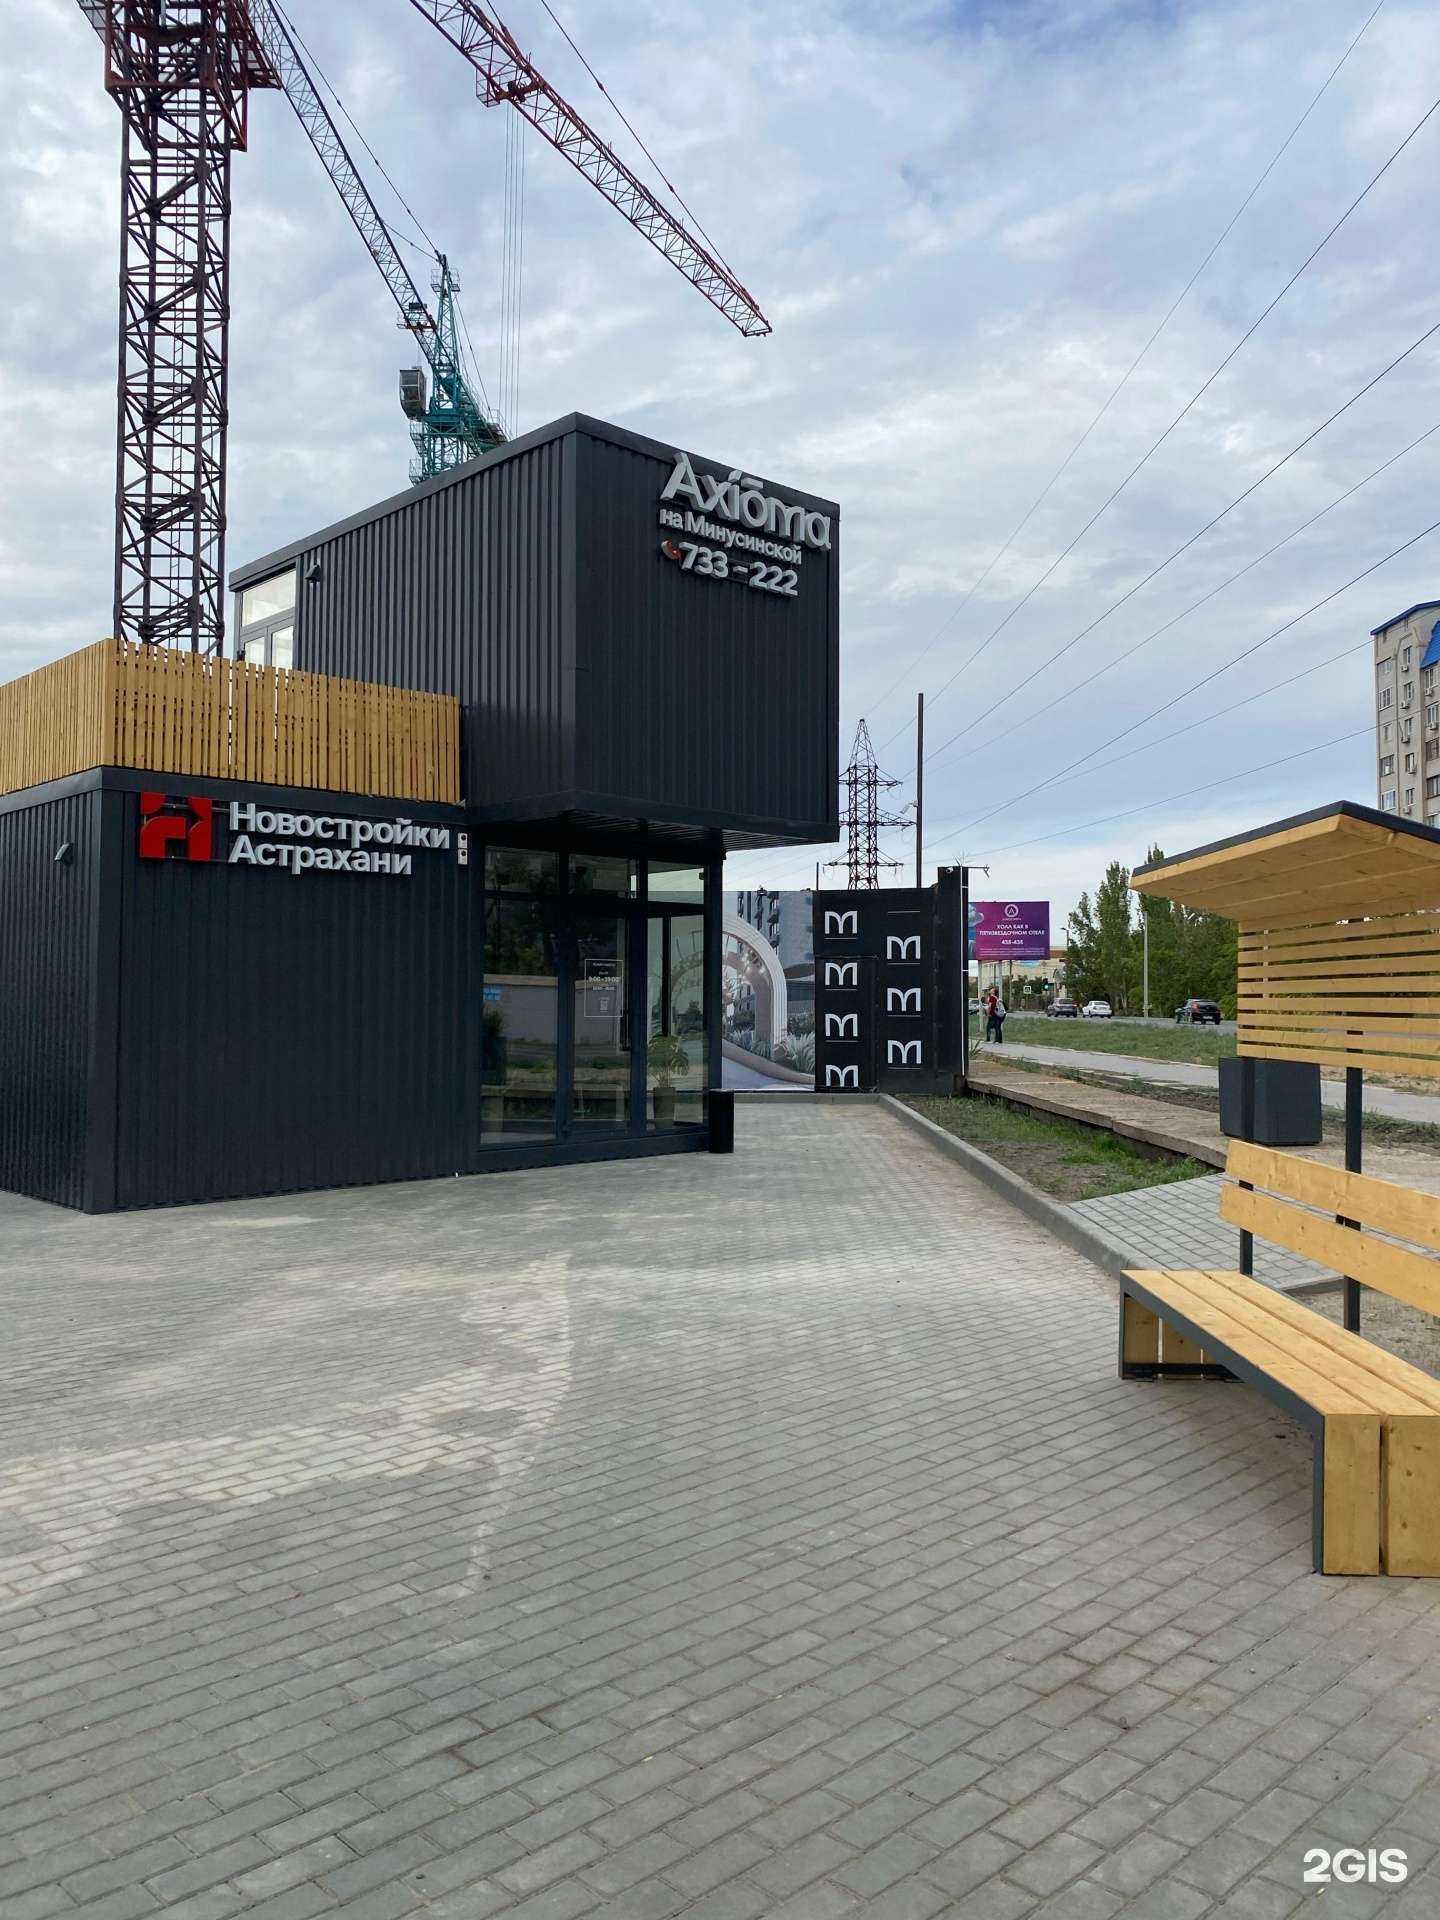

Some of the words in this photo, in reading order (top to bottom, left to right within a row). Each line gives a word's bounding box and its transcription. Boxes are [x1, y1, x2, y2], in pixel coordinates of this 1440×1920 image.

[660, 509, 683, 530] на
[685, 511, 801, 564] Минусинской
[229, 801, 450, 849] Новостройки
[228, 835, 412, 874] Астрахани
